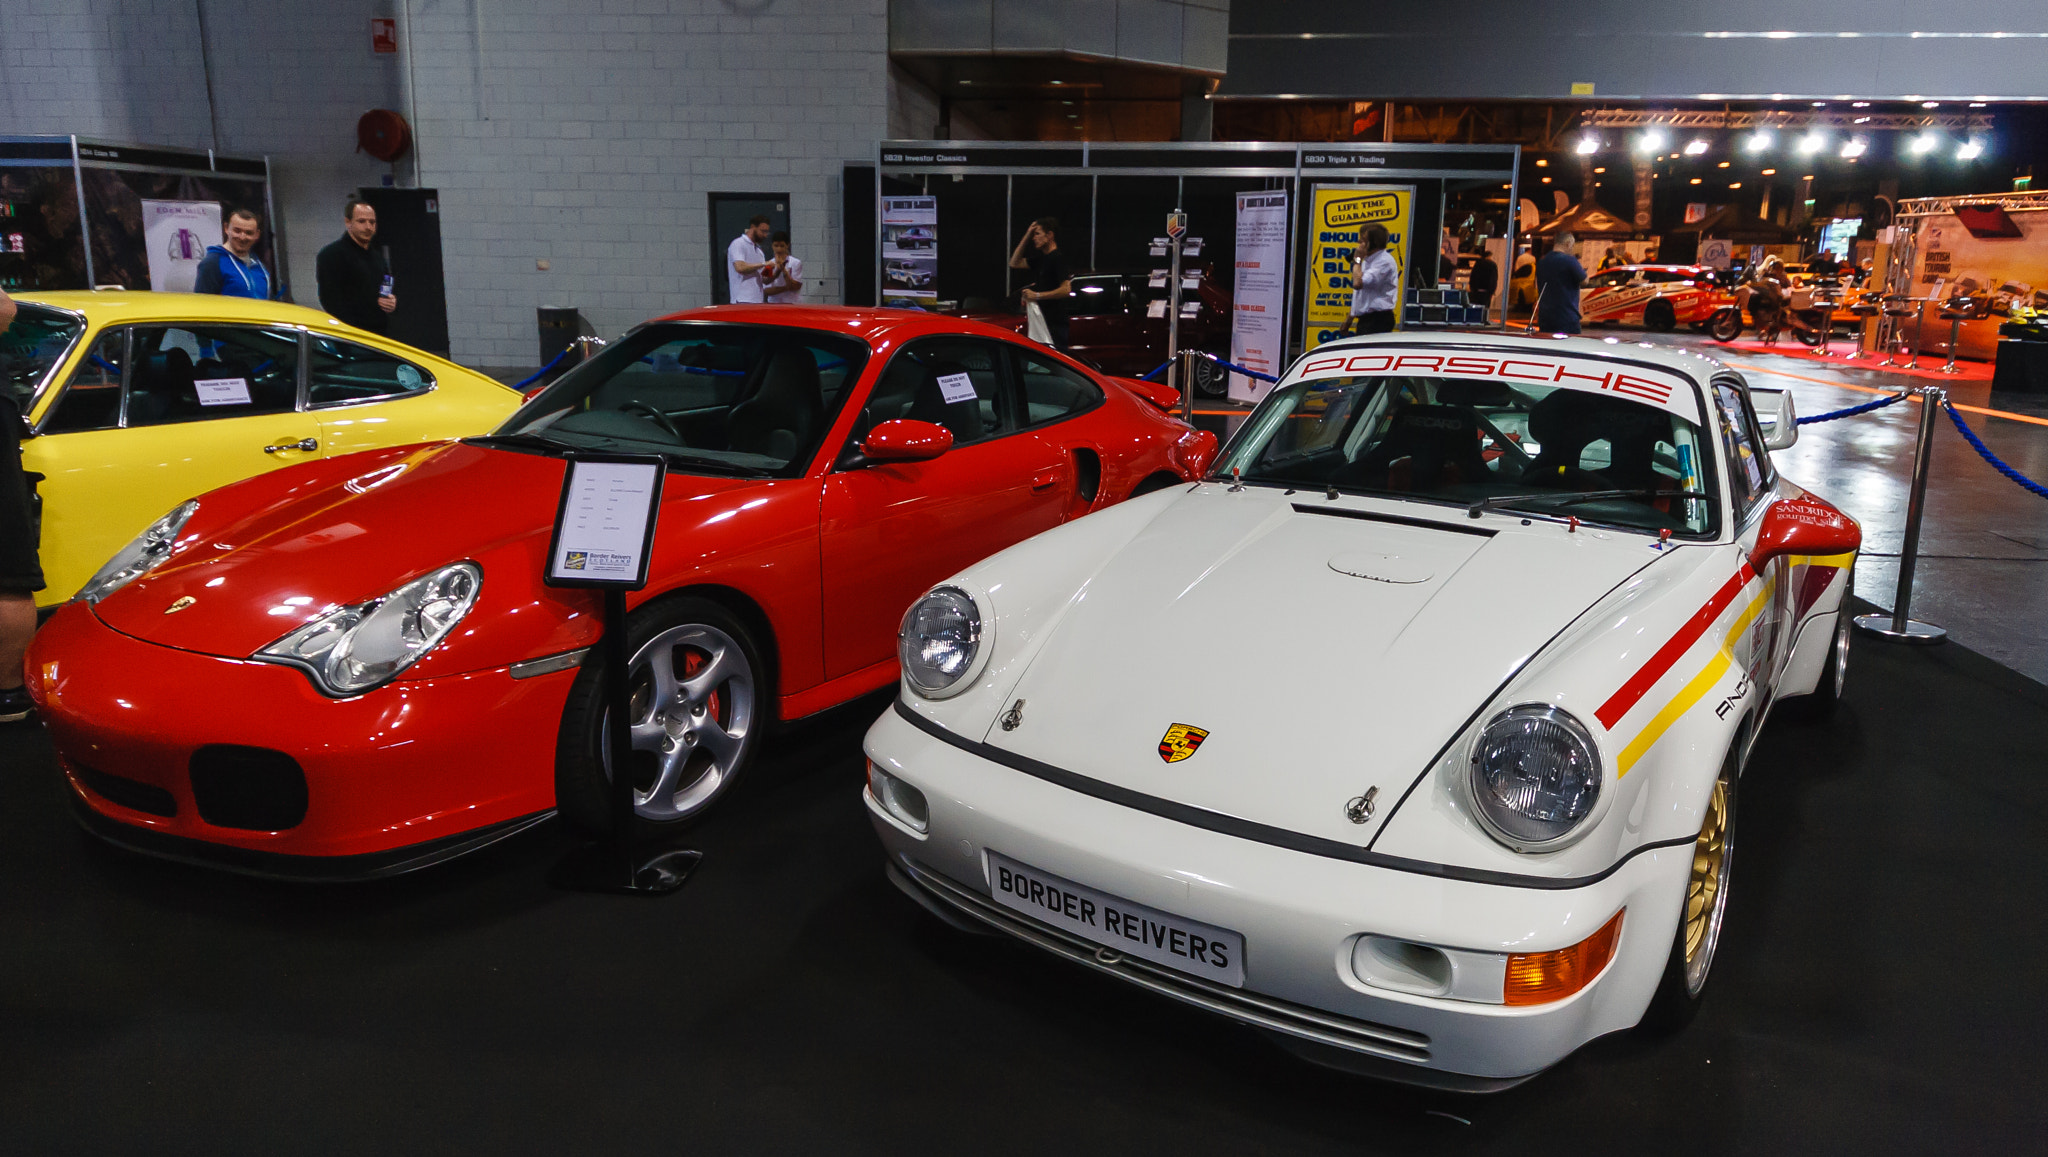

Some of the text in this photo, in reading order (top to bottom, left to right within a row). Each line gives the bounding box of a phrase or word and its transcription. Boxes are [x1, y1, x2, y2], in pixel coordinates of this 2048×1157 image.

[905, 154, 934, 162] Investor
[936, 154, 967, 162] Classics
[1328, 155, 1348, 164] Triple
[1359, 155, 1386, 165] Trading
[1337, 200, 1385, 212] LIFE TIME
[1331, 208, 1393, 222] GUARANTEE
[1925, 252, 1951, 262] BRITISH
[1924, 263, 1952, 273] TOURING
[1300, 355, 1673, 405] PORSCHE
[999, 866, 1229, 969] BORDER REIVERS
